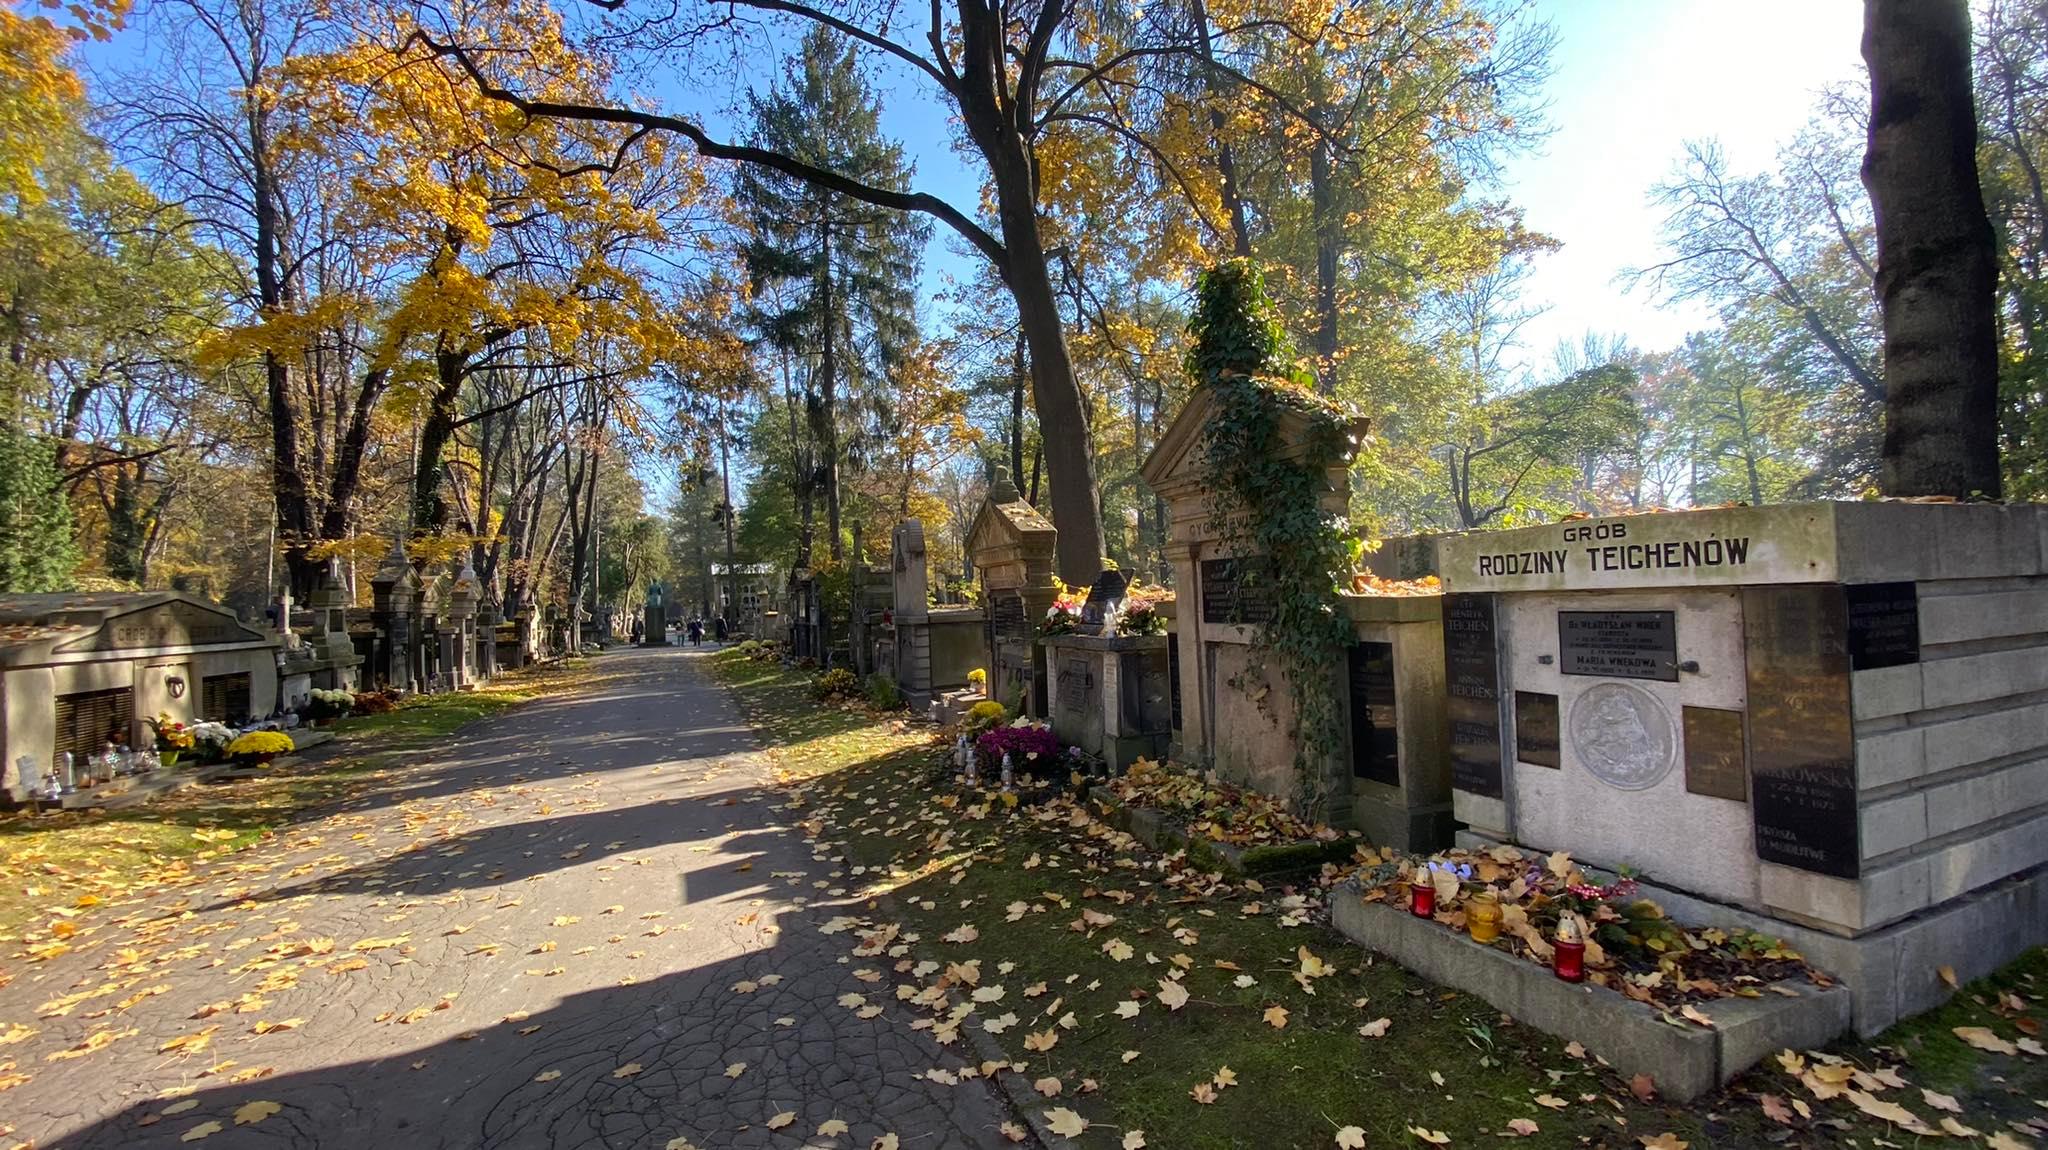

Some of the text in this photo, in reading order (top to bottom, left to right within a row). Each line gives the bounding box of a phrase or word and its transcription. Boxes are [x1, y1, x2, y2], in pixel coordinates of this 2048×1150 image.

[1563, 520, 1627, 542] GRÓB
[1479, 533, 1749, 577] RODZINY TEICHENÓW
[1448, 620, 1489, 632] TEICHEN
[1577, 655, 1605, 665] MARIA
